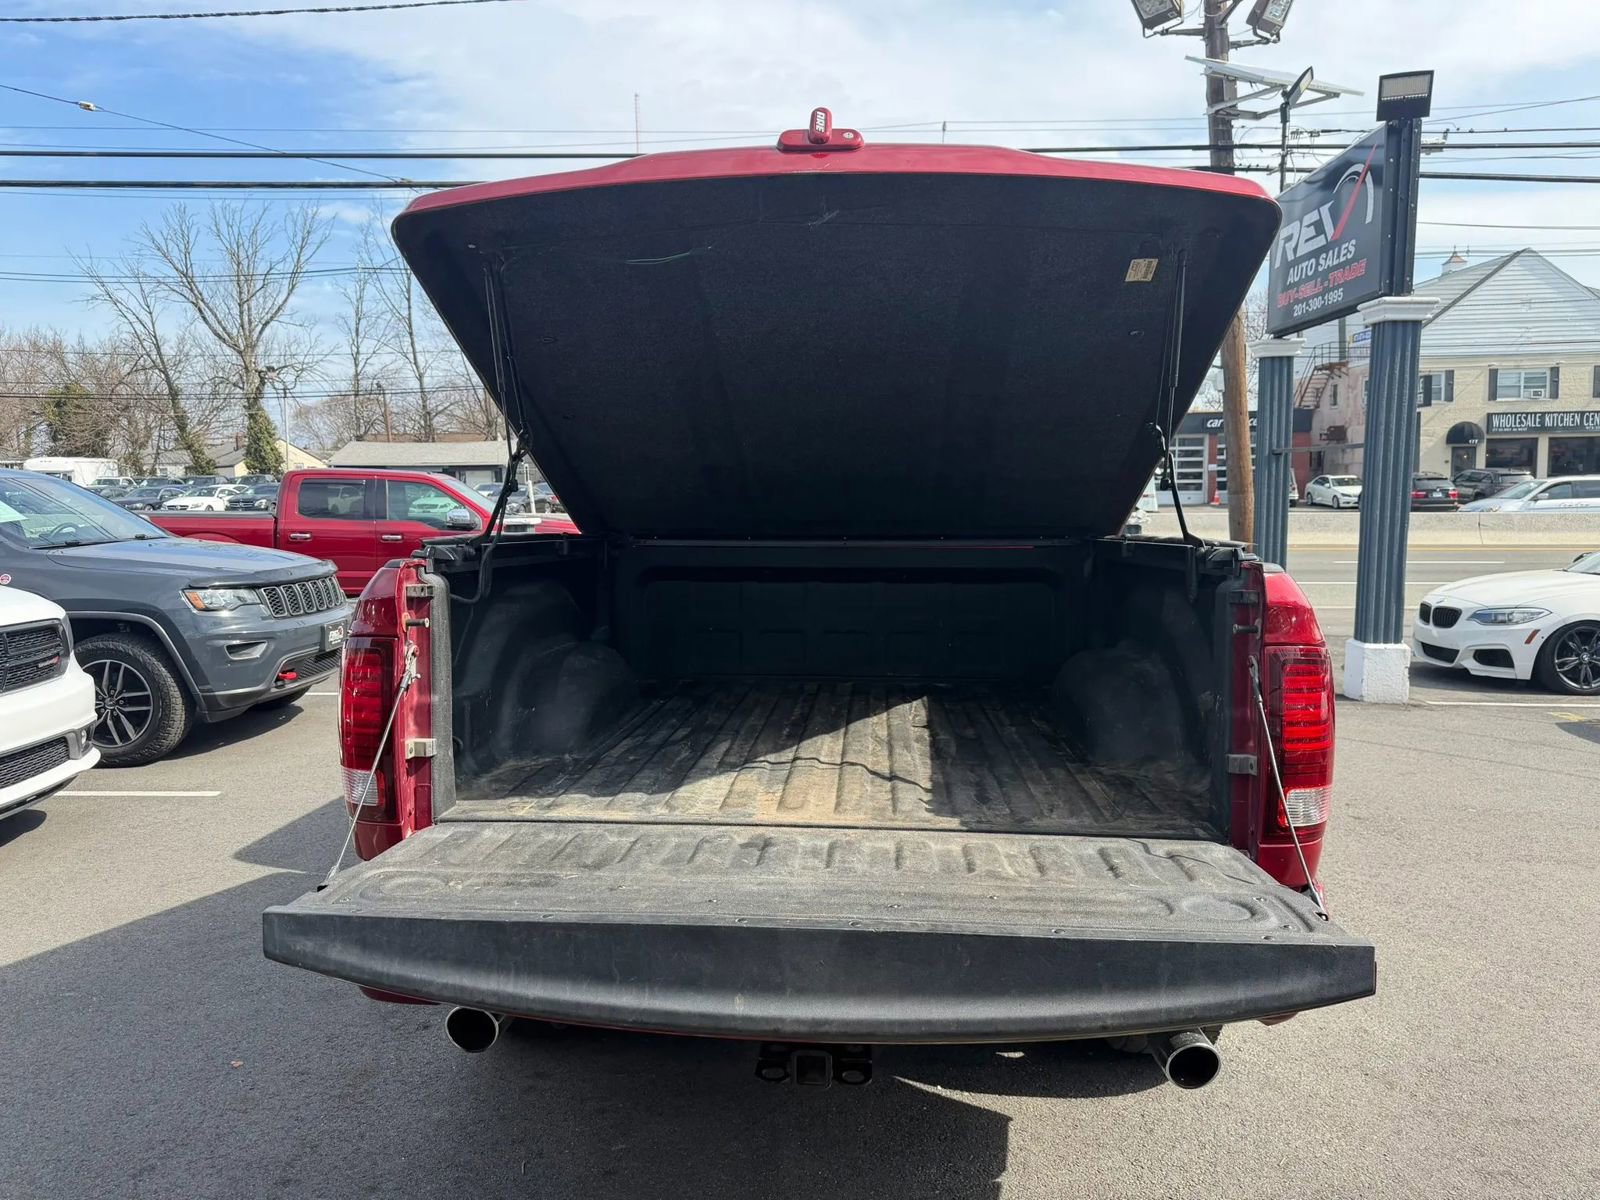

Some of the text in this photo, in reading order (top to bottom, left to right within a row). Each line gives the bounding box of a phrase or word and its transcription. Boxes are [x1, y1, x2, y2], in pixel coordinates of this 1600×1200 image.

[1287, 239, 1356, 286] AUTO SALES
[1293, 288, 1344, 317] 201-300-1995
[1492, 413, 1541, 427] WHOLESALE
[1544, 412, 1580, 427] KITCHEN
